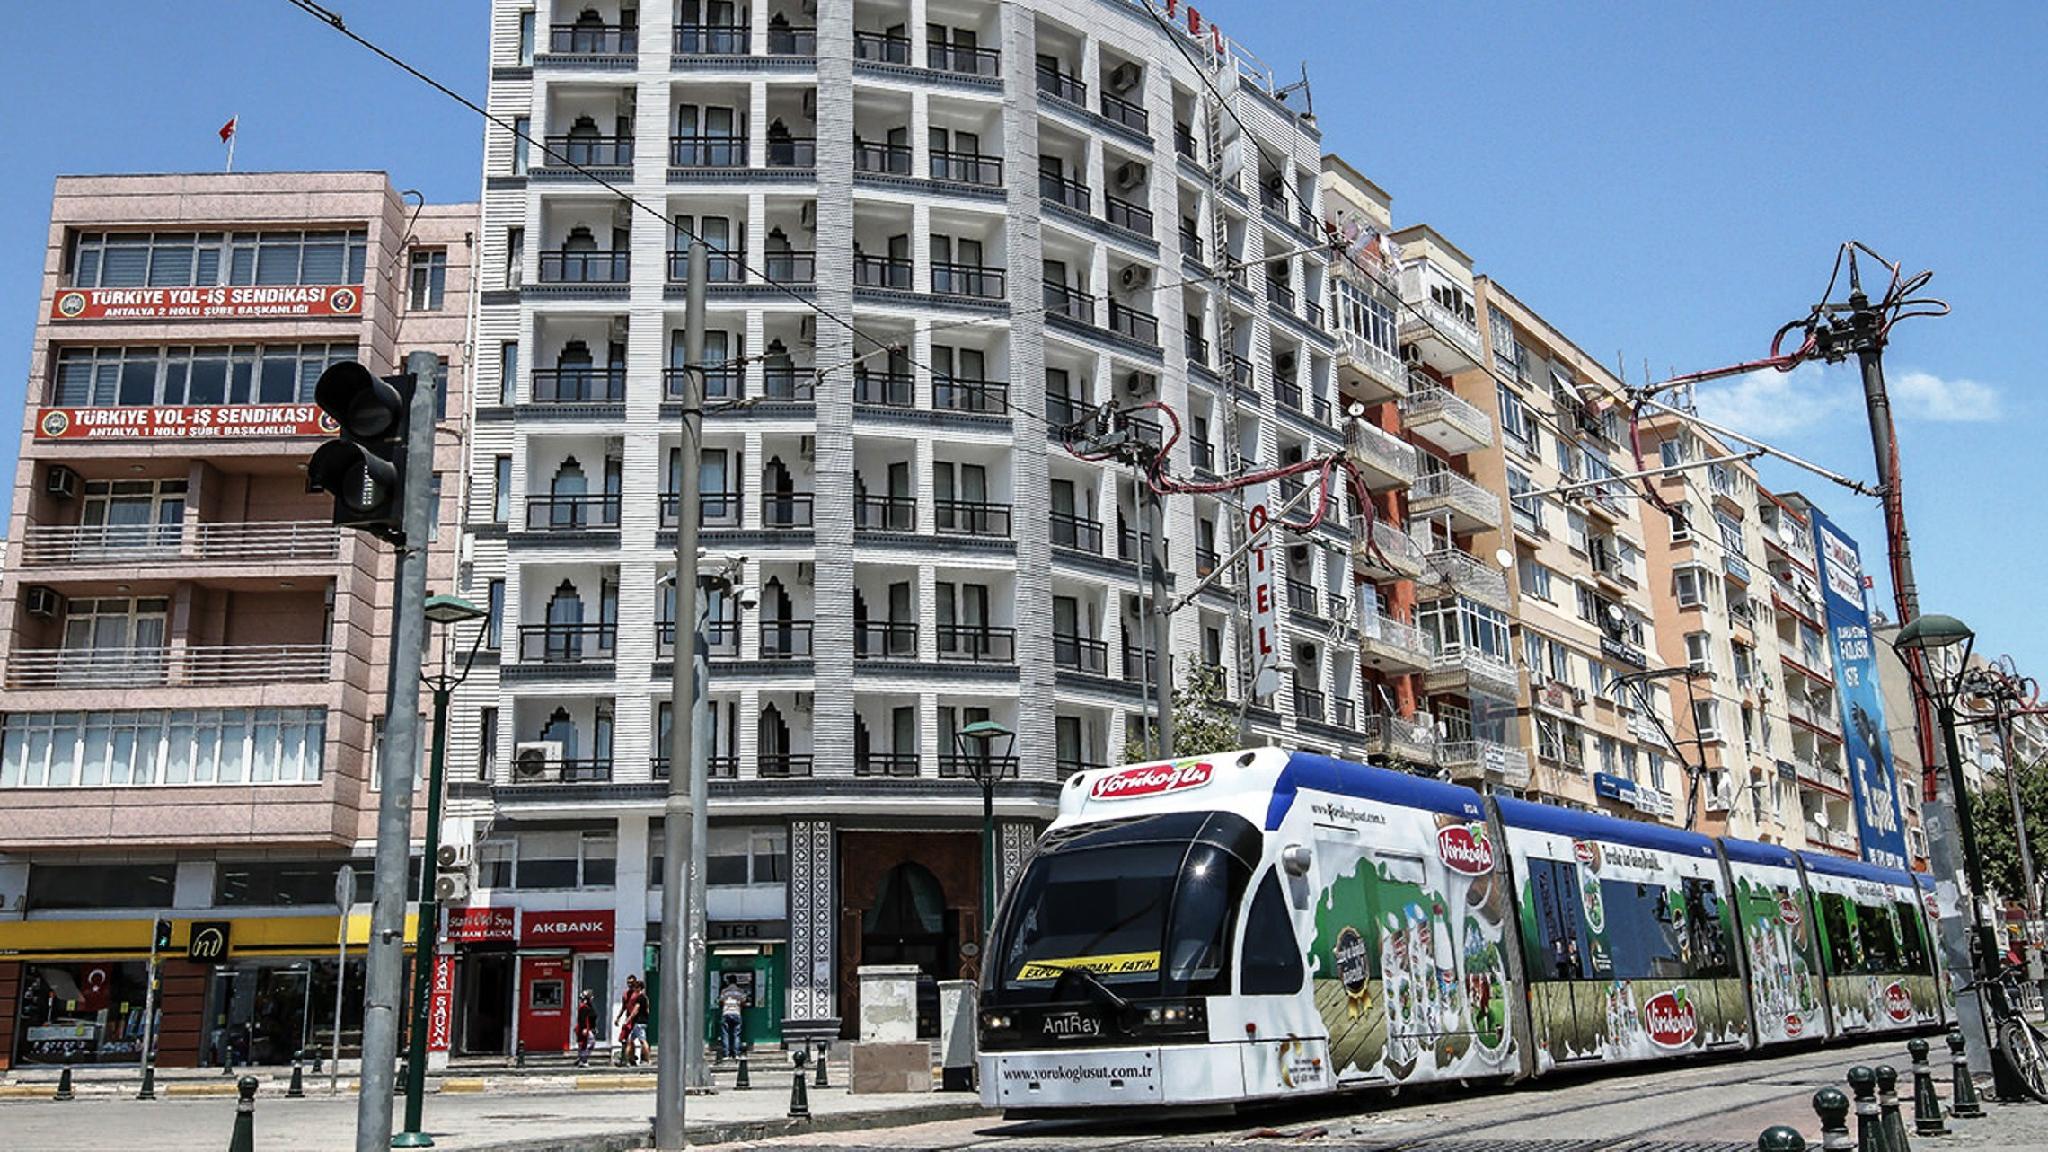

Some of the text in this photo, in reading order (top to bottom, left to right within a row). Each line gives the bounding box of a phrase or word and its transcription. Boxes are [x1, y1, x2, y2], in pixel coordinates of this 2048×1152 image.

[91, 289, 163, 305] TÜRKİYE
[231, 287, 326, 304] SENDİKASI
[104, 307, 155, 316] ANTALYA
[158, 307, 166, 316] 2
[168, 306, 200, 316] NOLU
[74, 409, 149, 426] TÜRKİYE
[216, 407, 314, 424] SENDİKASI
[88, 426, 140, 436] ANTALYA
[153, 426, 186, 436] NOLU
[1249, 504, 1273, 656] OTEL
[532, 922, 604, 934] AKBANK
[720, 925, 758, 937] TEB
[1042, 1016, 1101, 1035] AntRay
